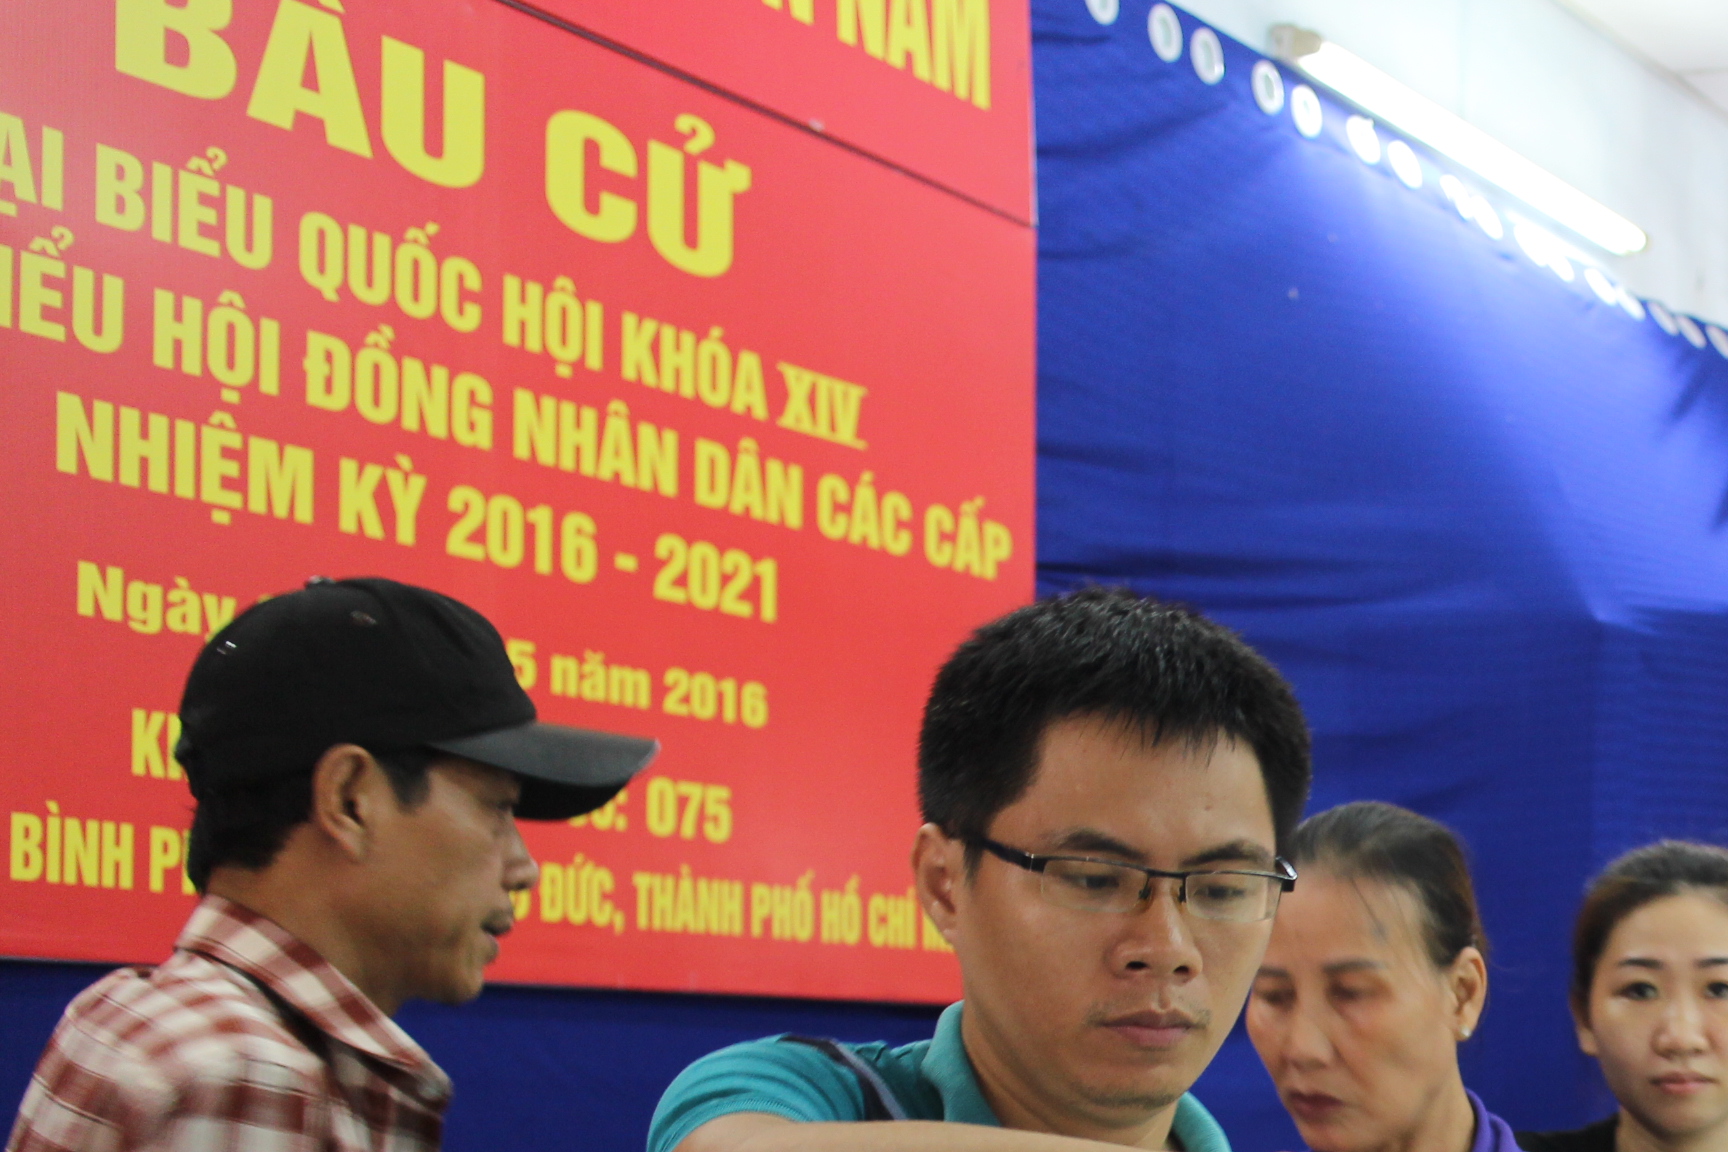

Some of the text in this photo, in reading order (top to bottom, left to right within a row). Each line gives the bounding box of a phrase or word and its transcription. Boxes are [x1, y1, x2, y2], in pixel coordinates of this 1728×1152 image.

[544, 109, 753, 279] CỬ
[95, 146, 274, 271] BIỂU
[299, 221, 483, 333] QUỐC
[502, 275, 603, 378] HỘI
[620, 310, 769, 422] KHÓA
[776, 360, 869, 450] XIV
[55, 390, 778, 624] NHIỆM KỲ 2016 - 2021
[152, 289, 281, 405] HỘI
[303, 323, 494, 452] ĐỒNG
[512, 387, 679, 498] NHÂN
[694, 437, 803, 531] DÂN
[816, 470, 914, 557] CÁC
[923, 495, 1013, 582] CẤP
[77, 560, 238, 644] Ngày
[549, 648, 652, 711] năm
[662, 665, 770, 729] 2016
[10, 799, 134, 890] BÌNH
[632, 863, 744, 937] THÀNH
[750, 869, 815, 944] PHỐ
[645, 775, 733, 844] 075
